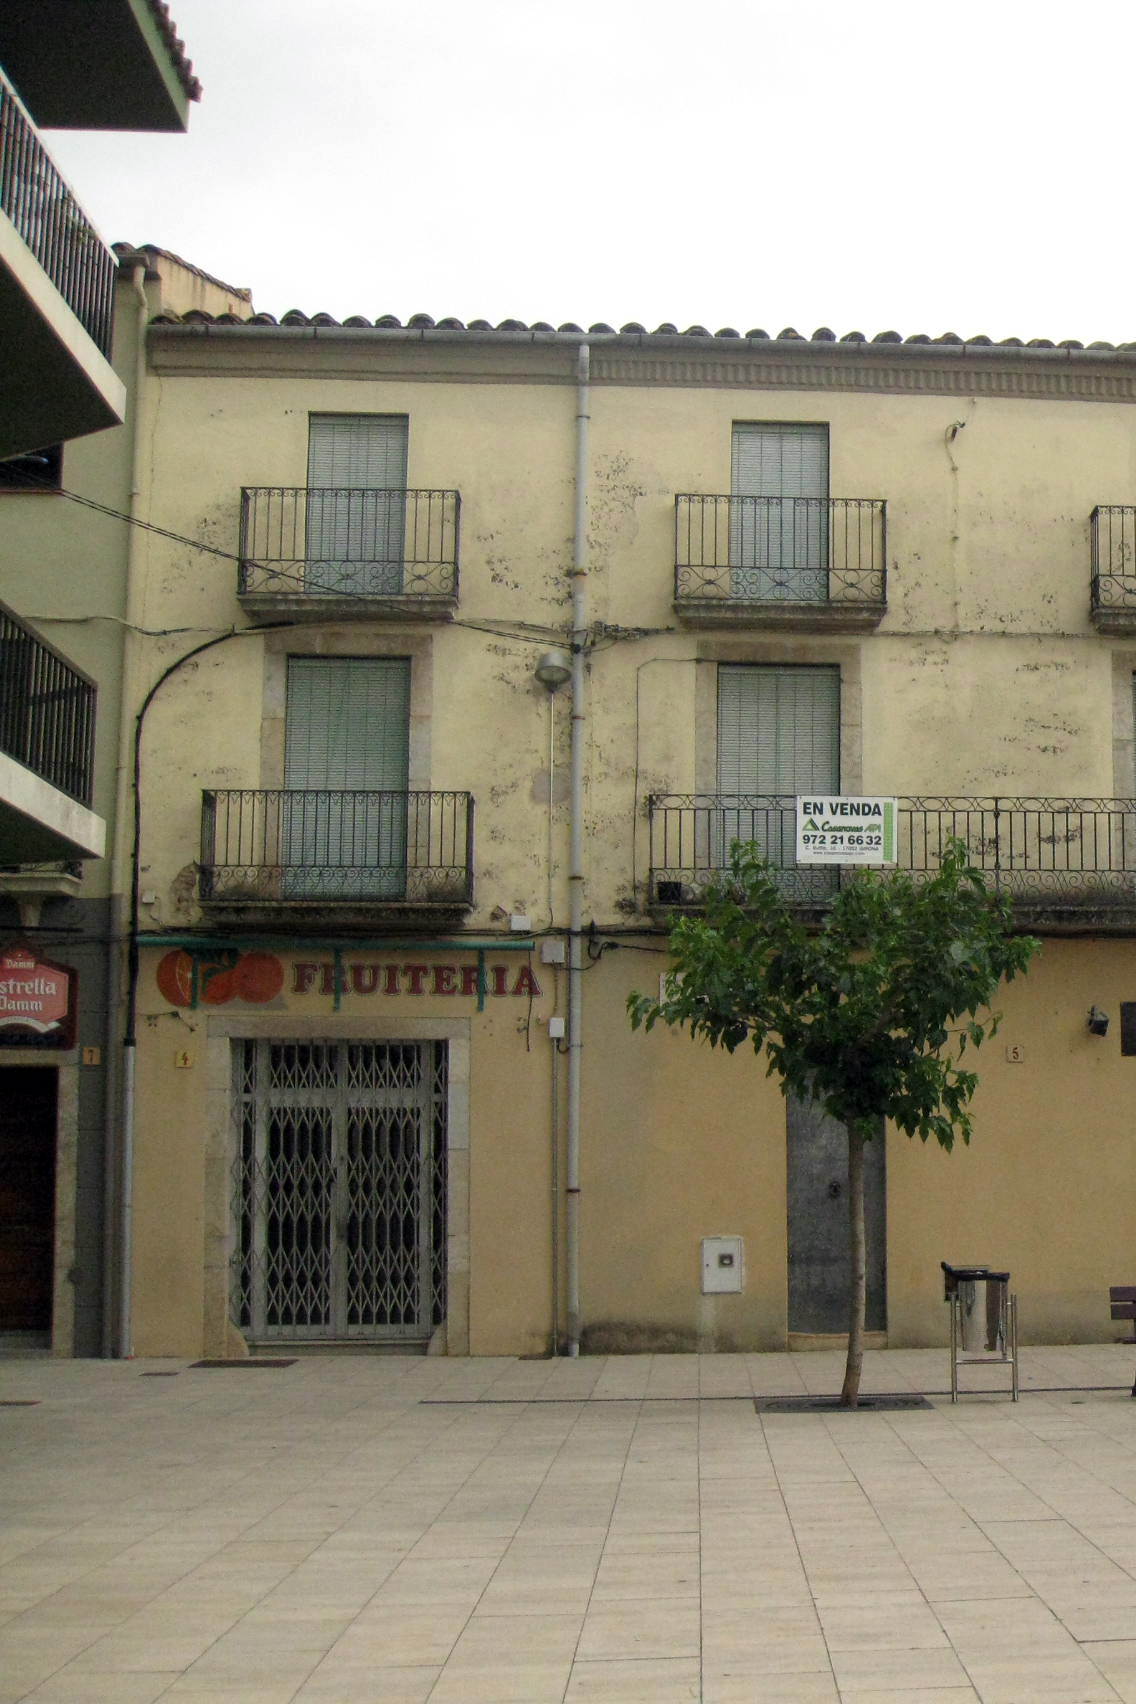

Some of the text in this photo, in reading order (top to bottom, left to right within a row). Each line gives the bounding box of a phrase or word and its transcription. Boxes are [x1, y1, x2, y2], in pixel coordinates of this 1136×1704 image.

[803, 801, 882, 816] EN VENDA
[803, 834, 882, 845] 972 21 66 32
[0, 976, 57, 995] strella
[291, 961, 543, 997] FRUITERIA
[1012, 1046, 1020, 1061] 5
